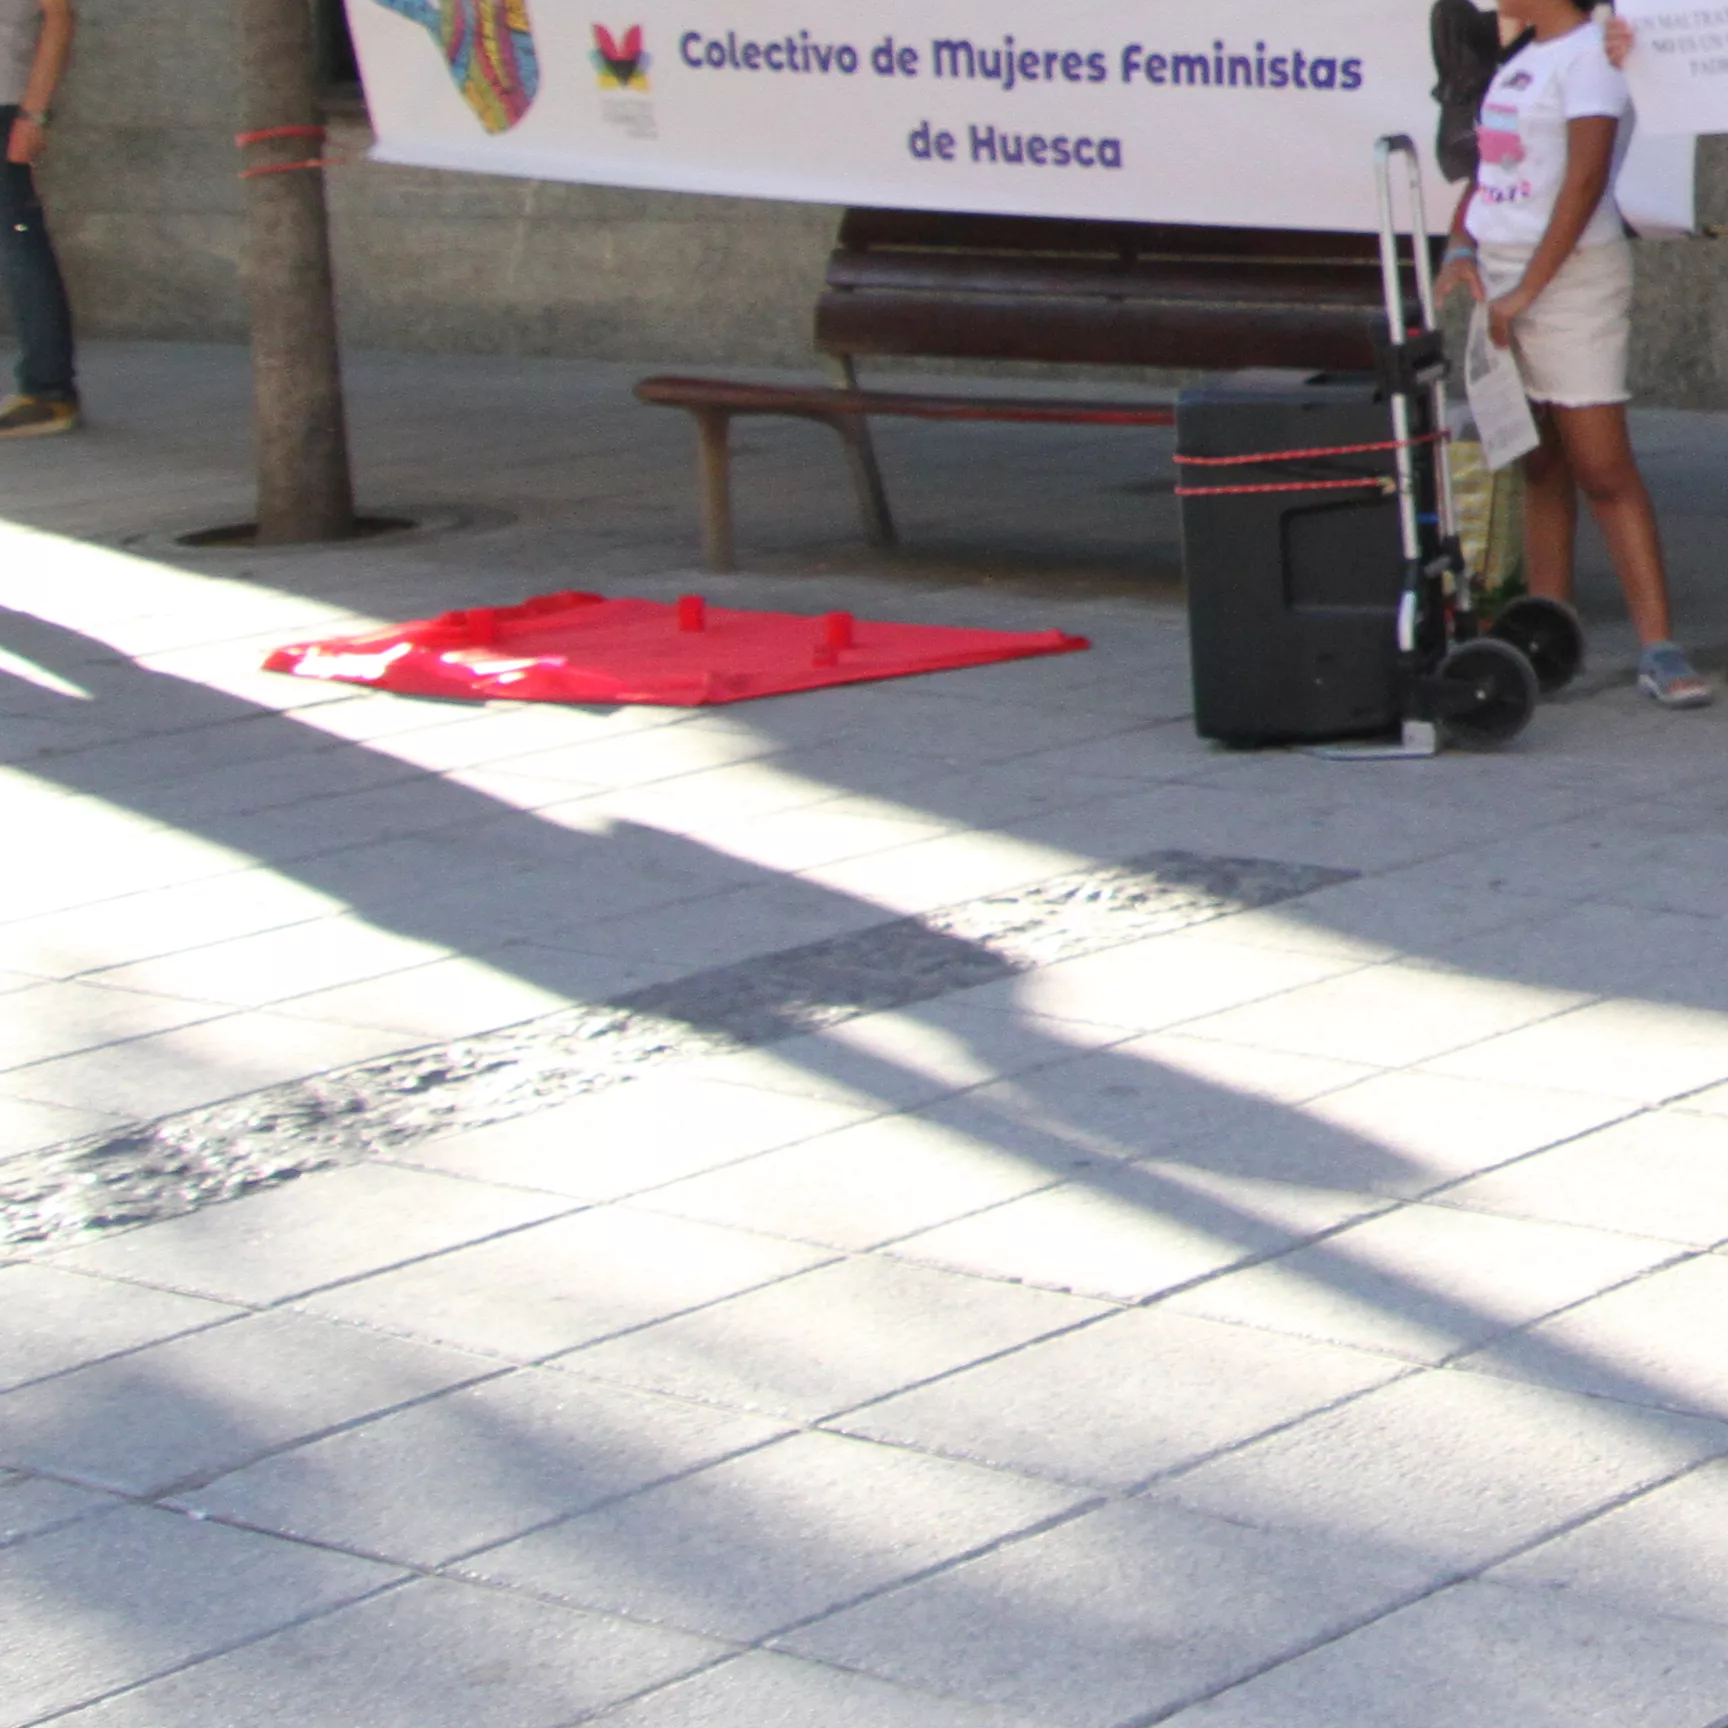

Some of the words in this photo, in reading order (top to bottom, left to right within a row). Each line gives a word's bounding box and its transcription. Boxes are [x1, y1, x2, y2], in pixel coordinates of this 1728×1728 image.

[679, 29, 859, 75] Colectivo
[870, 36, 919, 77] de
[932, 35, 1108, 91] Mujeres
[1121, 39, 1363, 91] Feministas
[907, 119, 956, 162] de
[968, 124, 1123, 169] Huesca
